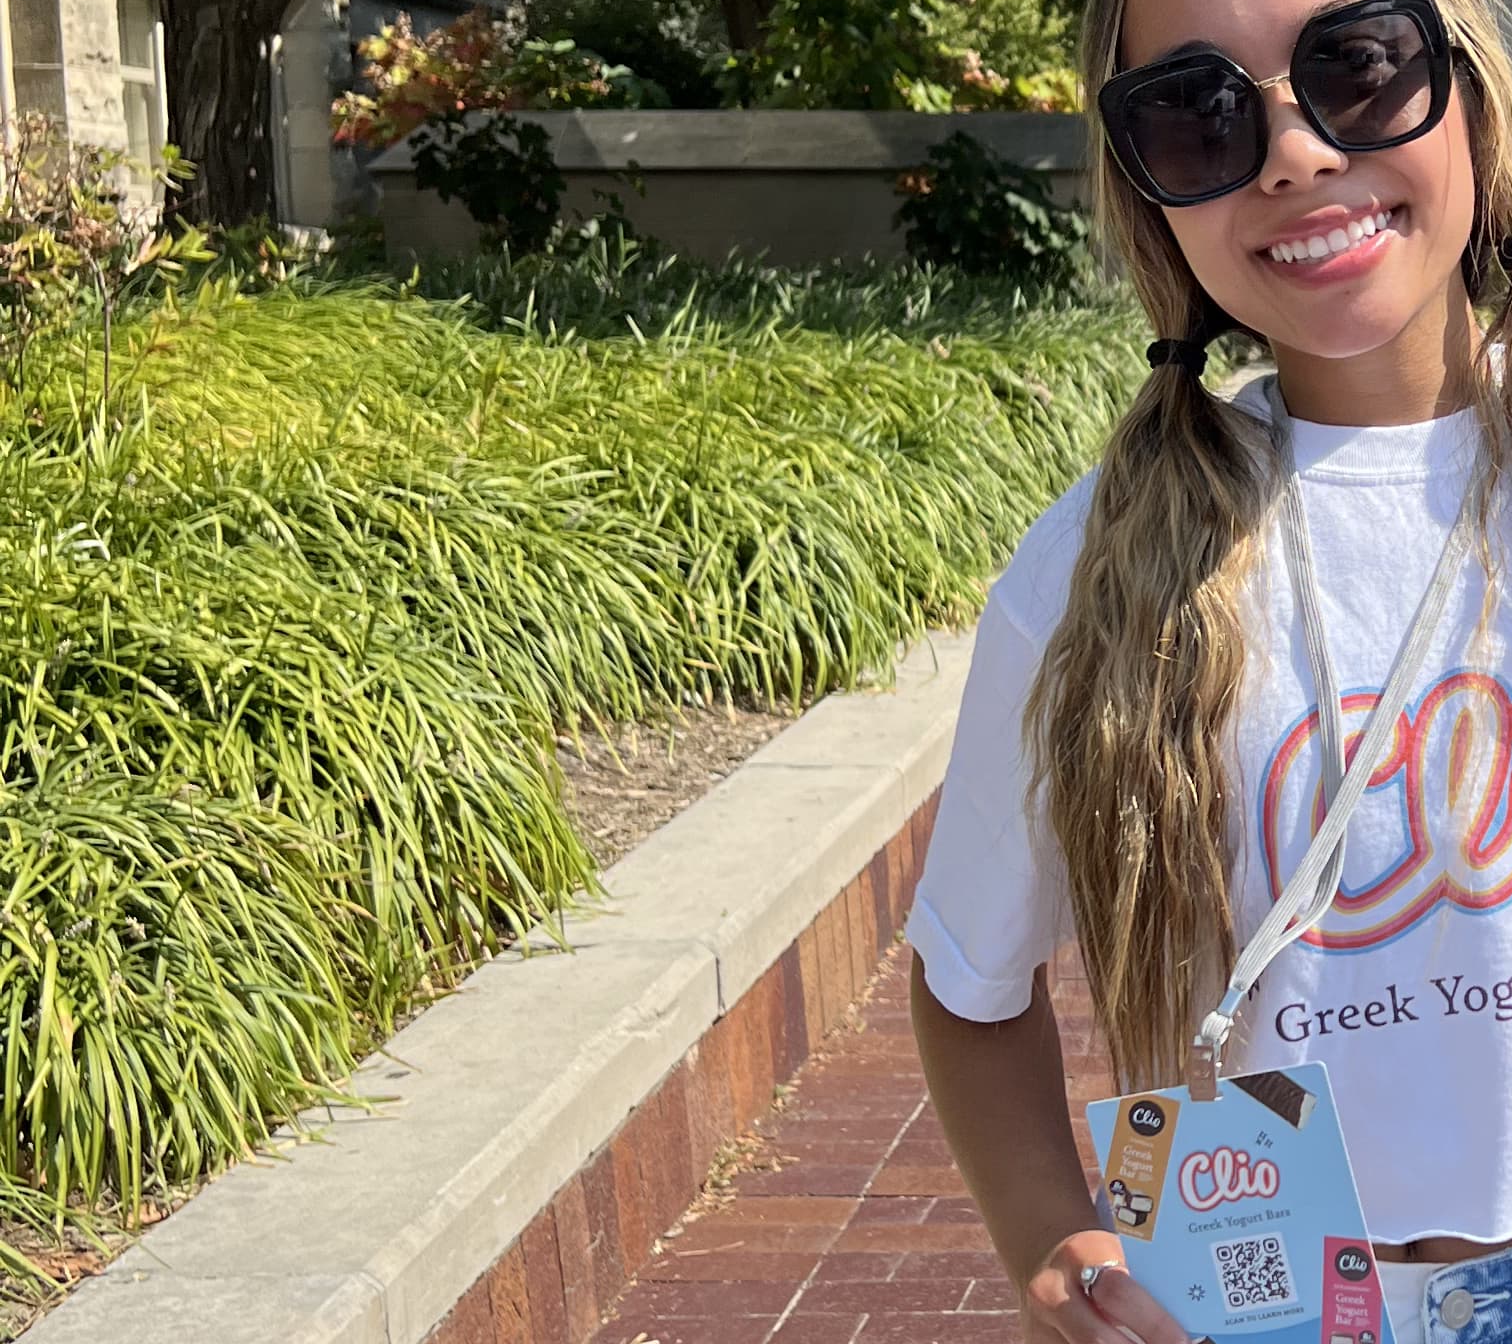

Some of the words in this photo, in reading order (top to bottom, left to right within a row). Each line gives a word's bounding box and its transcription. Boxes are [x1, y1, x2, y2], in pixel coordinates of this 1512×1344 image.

[1275, 984, 1419, 1043] Greek
[1133, 1108, 1160, 1128] Clio
[1178, 1146, 1279, 1212] Clio
[1188, 1218, 1223, 1233] Greek
[1224, 1213, 1263, 1227] Yogurt
[1339, 1254, 1368, 1272] Clio
